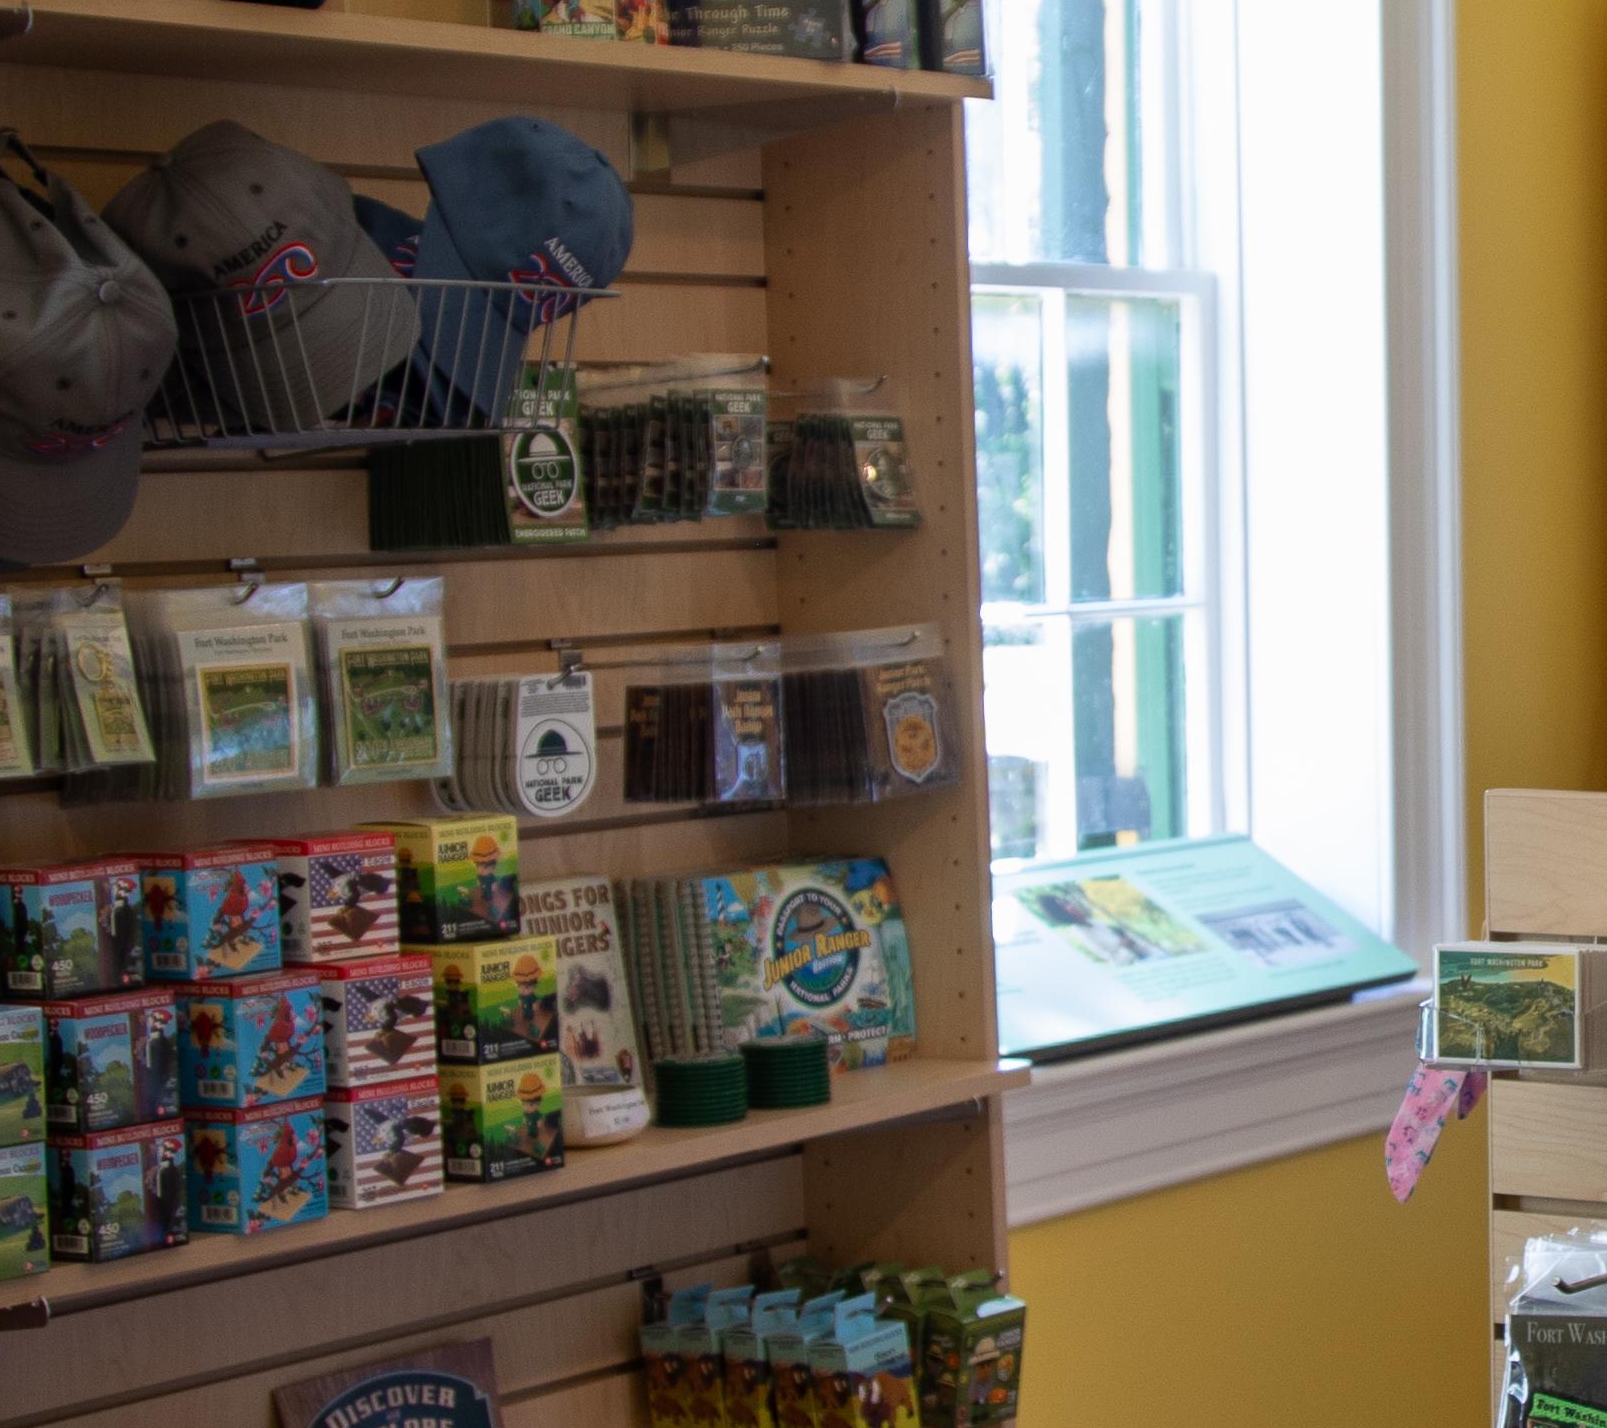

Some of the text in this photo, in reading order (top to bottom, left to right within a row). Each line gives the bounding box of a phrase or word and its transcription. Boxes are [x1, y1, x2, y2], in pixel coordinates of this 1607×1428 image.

[687, 4, 790, 23] Through Time
[211, 219, 290, 282] AMERICA
[726, 401, 752, 414] GEEK
[533, 489, 566, 508] GEEK
[341, 624, 426, 642] Fort Washington Park
[534, 785, 573, 803] GEEK
[775, 891, 843, 937] PASSPORT TO YOUR
[525, 911, 594, 937] JUNIOR
[762, 928, 872, 990] JUNIOR RANGER
[788, 965, 855, 1004] NATIONAL PARKS
[849, 1026, 890, 1044] PROTECT
[1526, 1321, 1564, 1345] FORT
[1536, 1398, 1562, 1415] Fort
